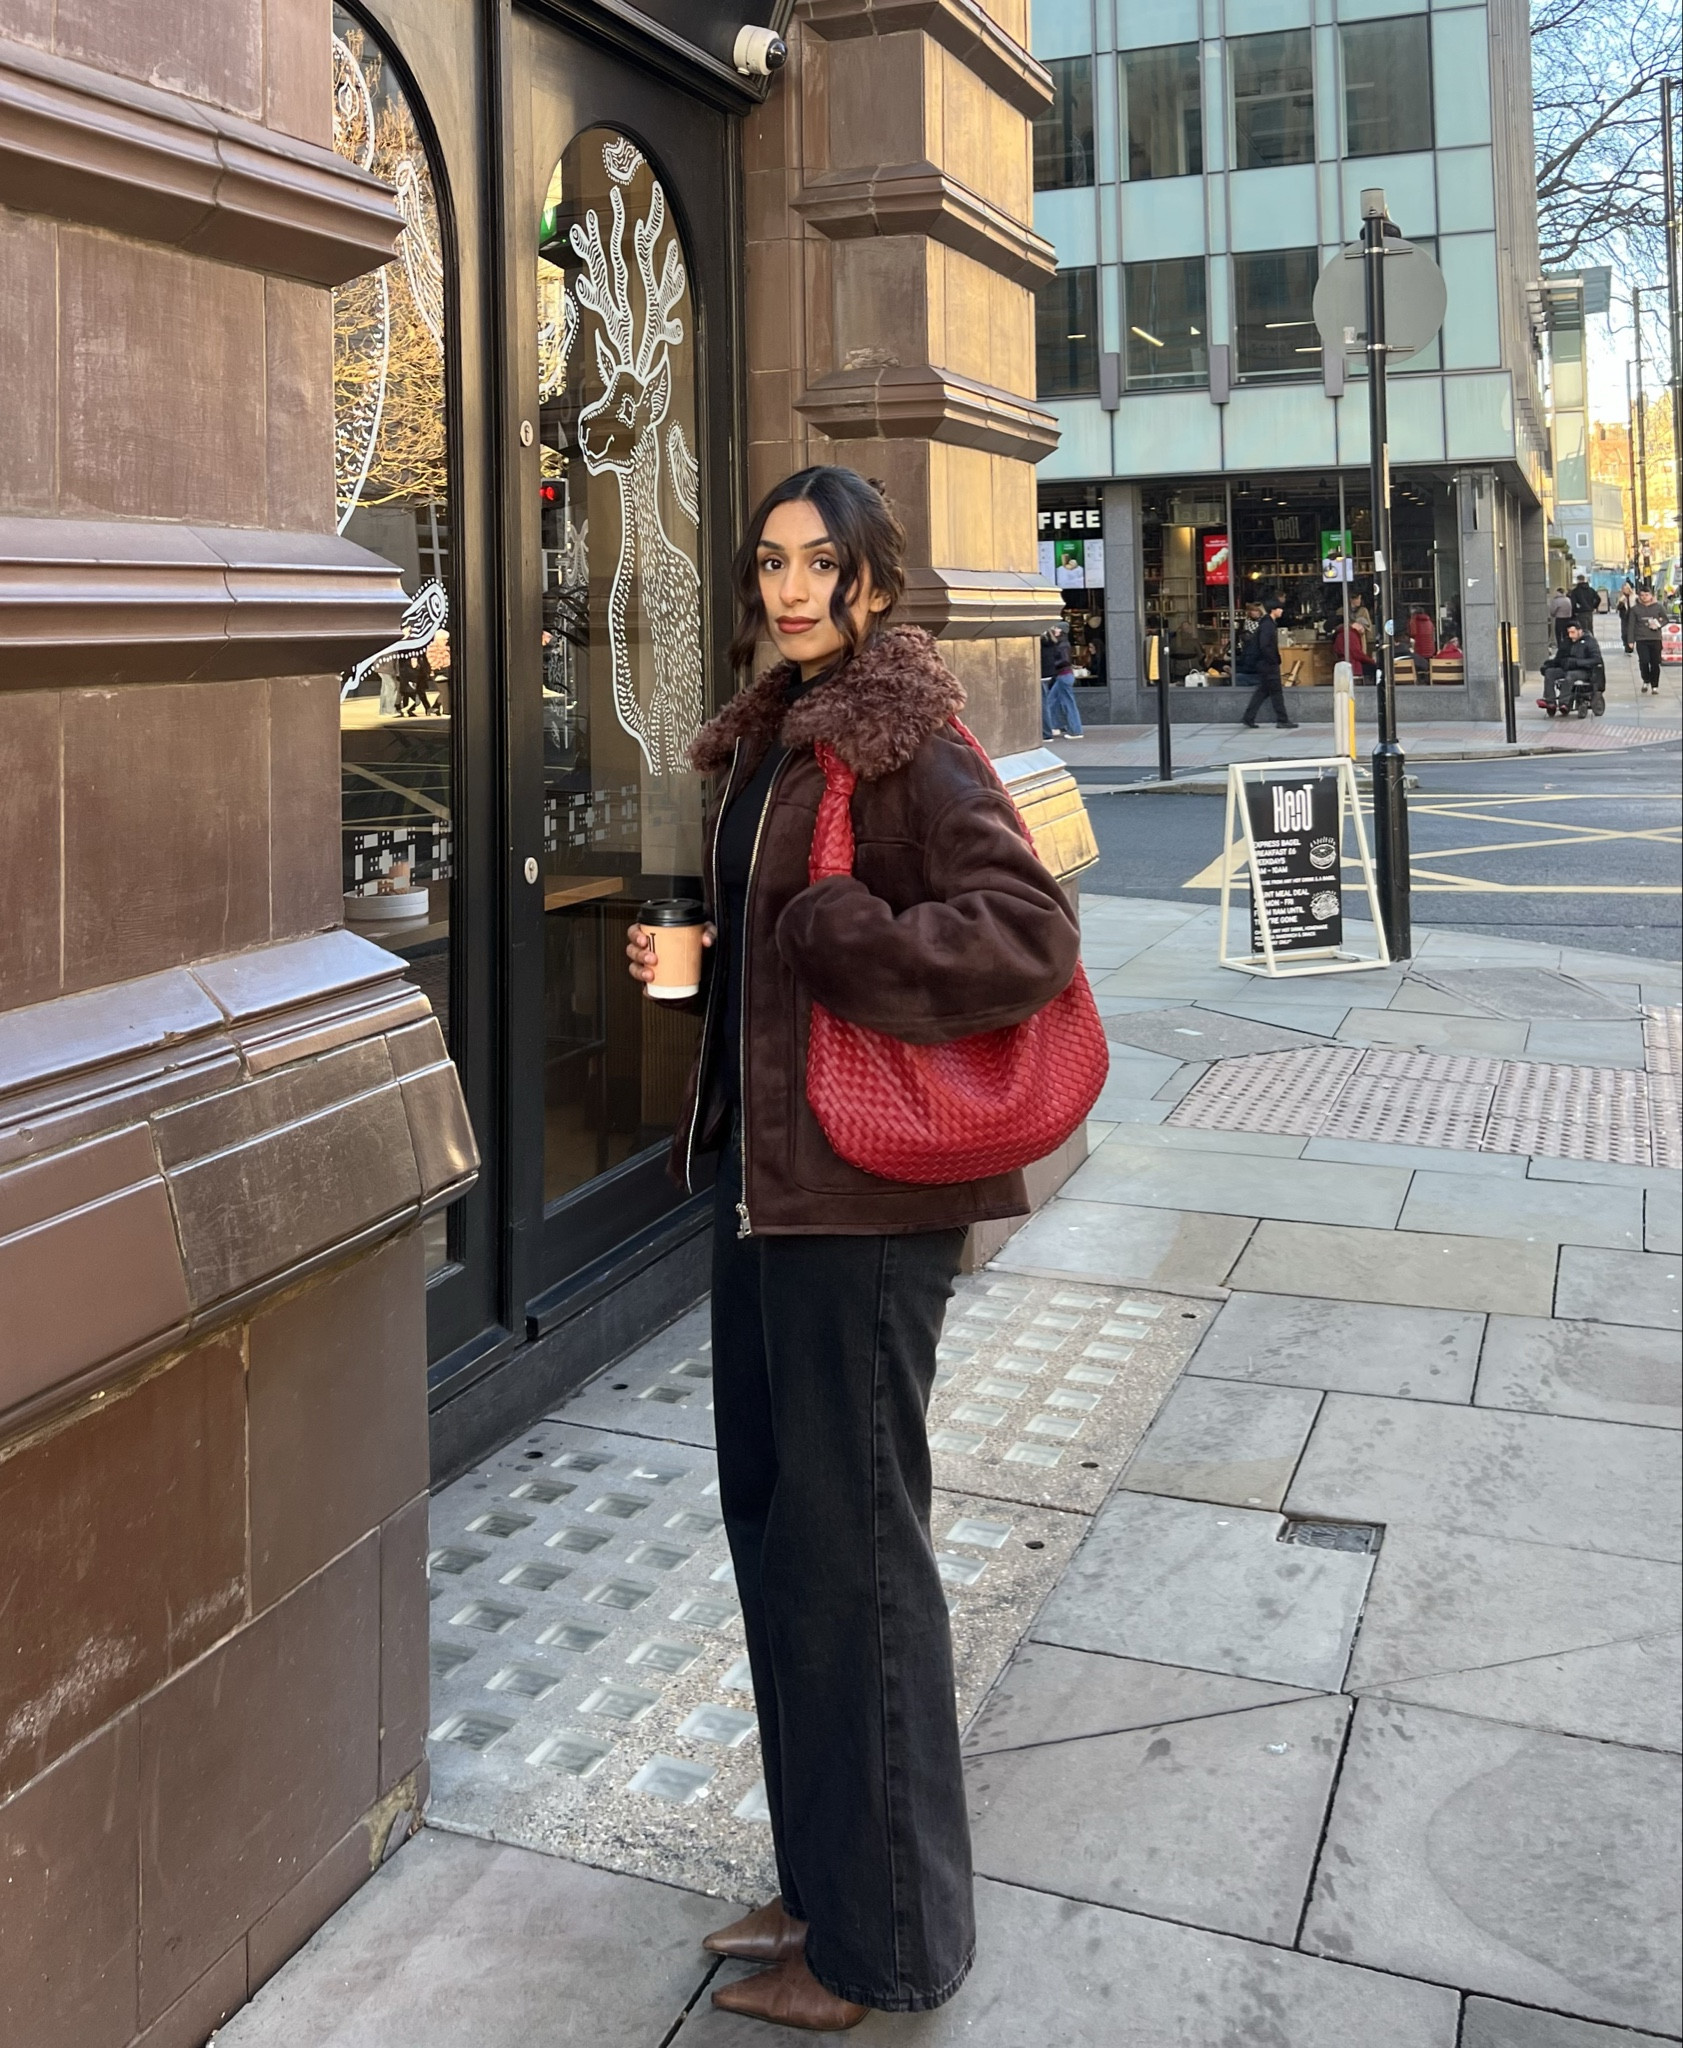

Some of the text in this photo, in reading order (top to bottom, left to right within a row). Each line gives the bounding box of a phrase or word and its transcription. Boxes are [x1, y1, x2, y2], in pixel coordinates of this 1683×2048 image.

[1038, 510, 1100, 530] FFEE
[1281, 838, 1302, 846] BAGEL
[1255, 848, 1287, 856] REAKFAST
[1257, 857, 1286, 866] EEKDAYS
[1293, 888, 1310, 896] DEAL
[1280, 915, 1298, 924] GONE
